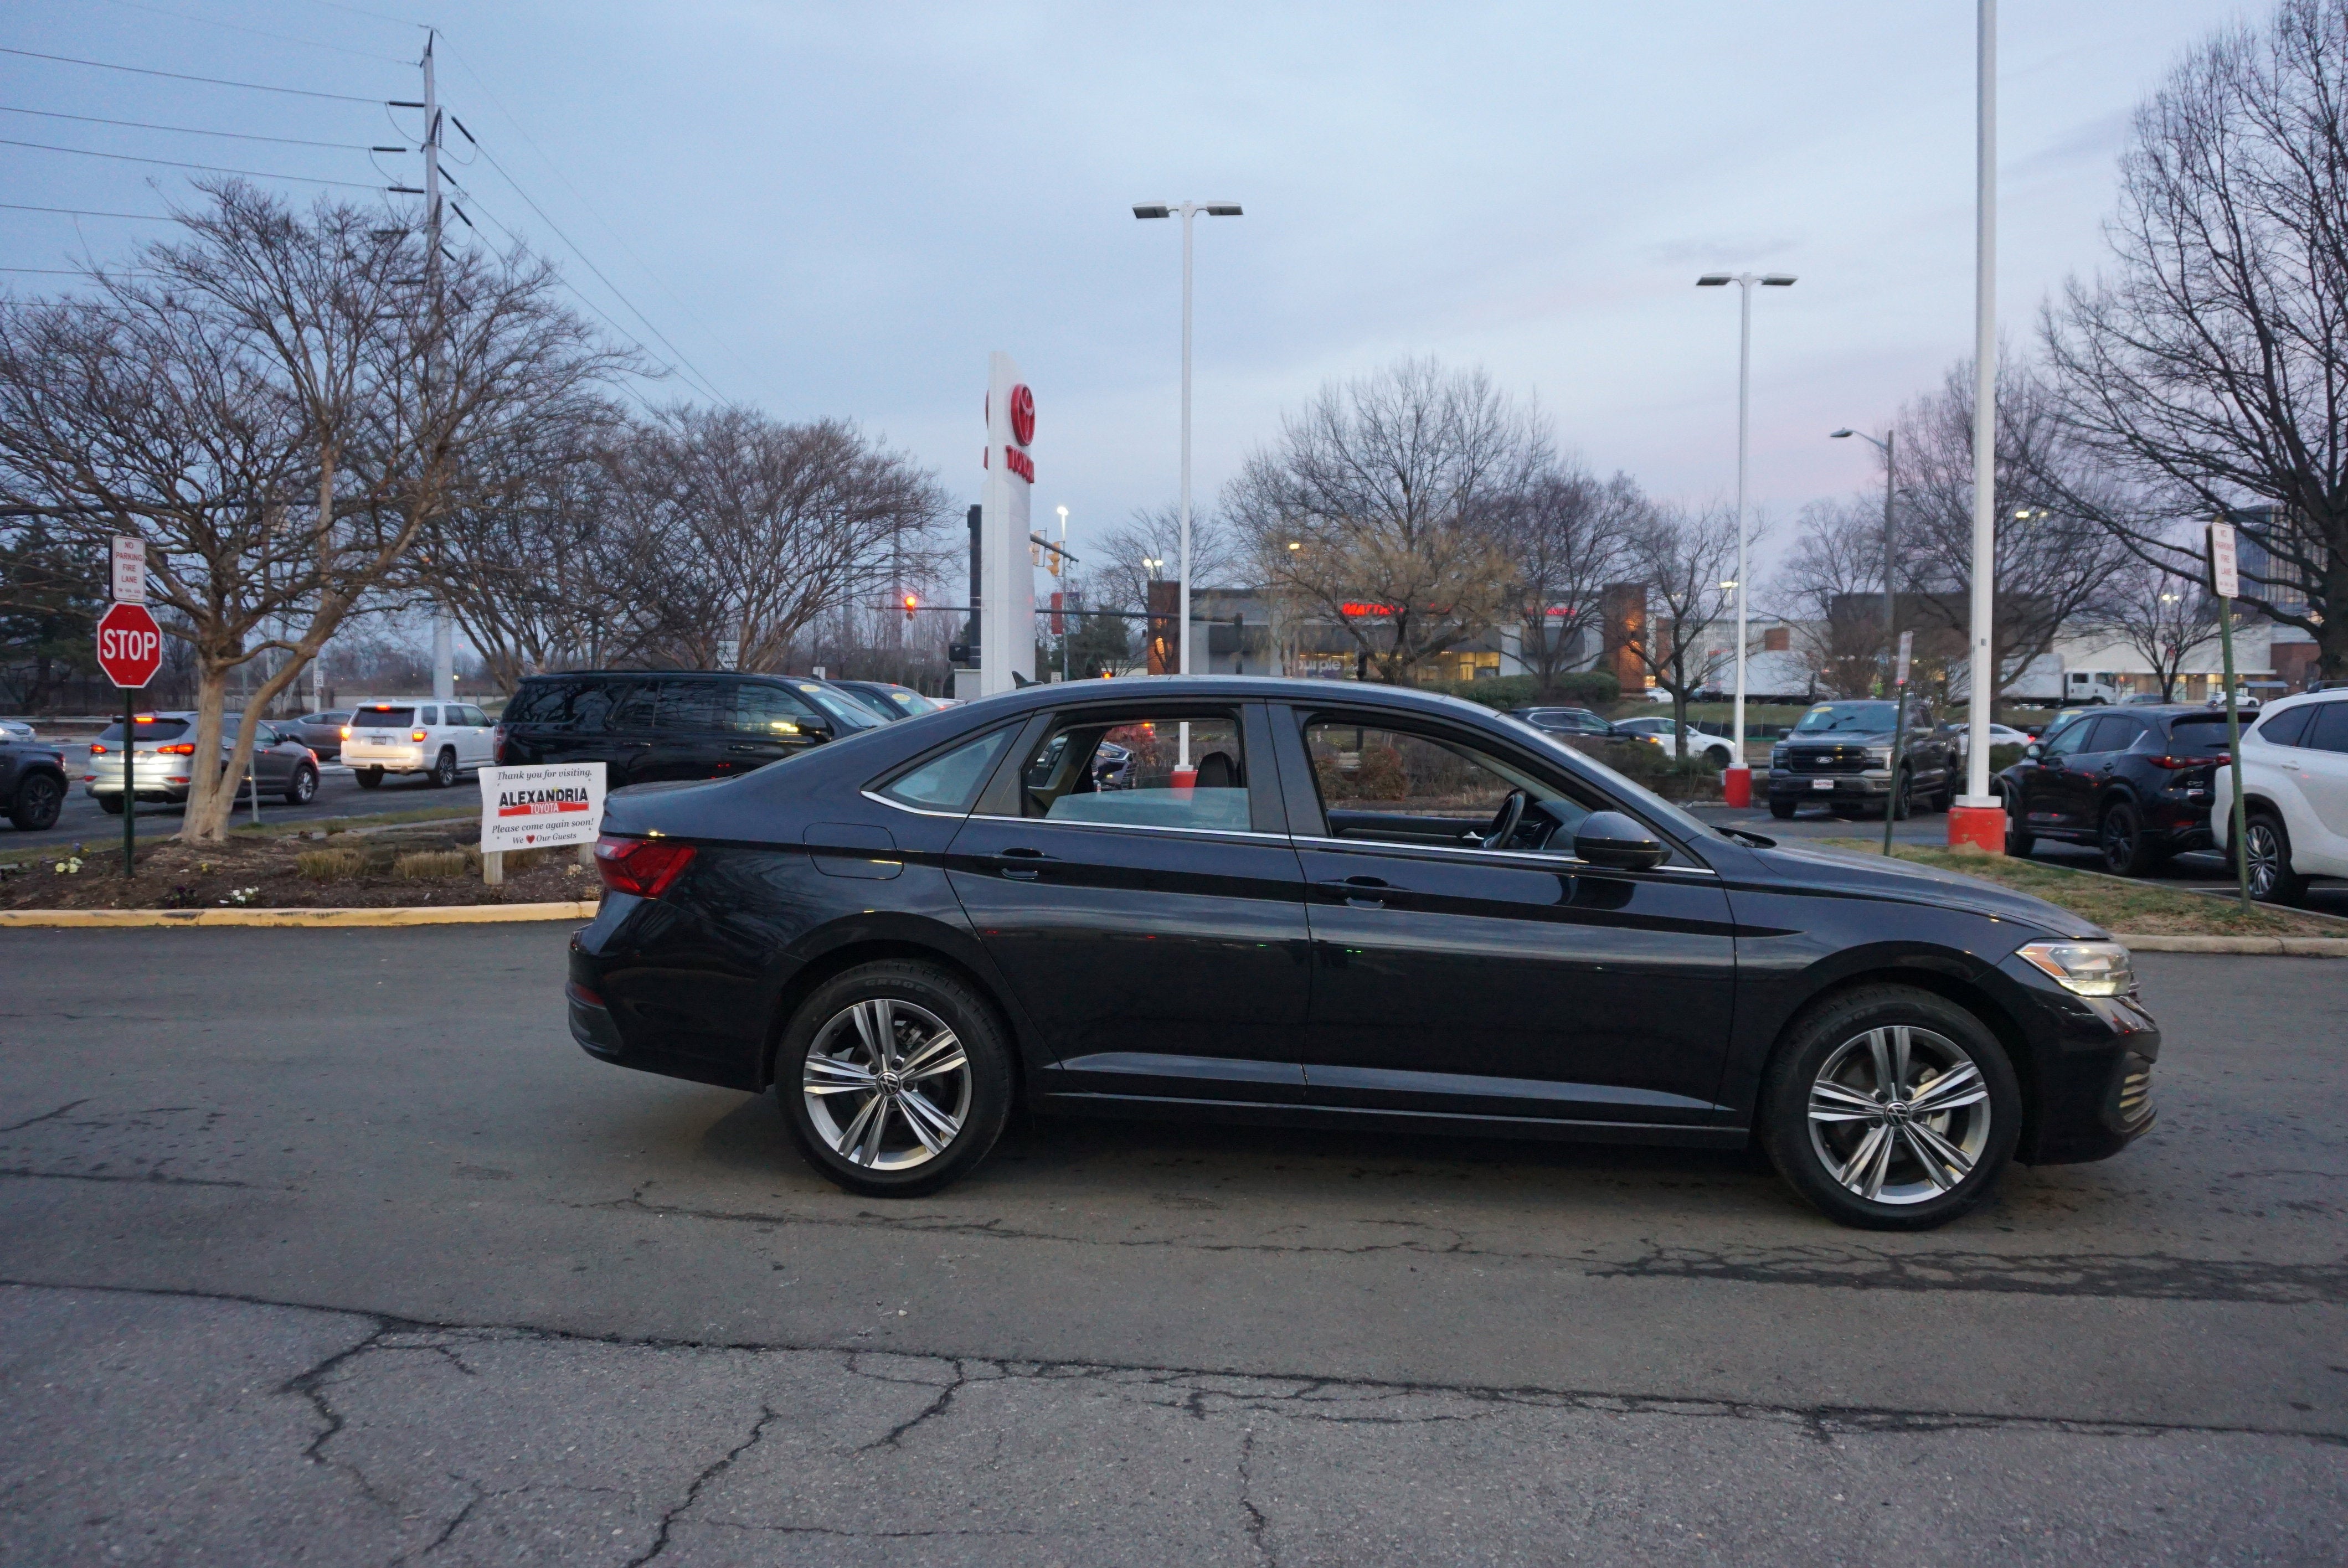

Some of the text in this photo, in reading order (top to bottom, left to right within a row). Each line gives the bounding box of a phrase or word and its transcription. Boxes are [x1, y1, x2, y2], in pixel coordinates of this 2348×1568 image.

[2216, 541, 2234, 551] PARKING
[115, 551, 143, 561] PARKING
[2221, 554, 2230, 563] FIRE
[122, 564, 136, 572] FIRE
[2221, 567, 2232, 576] LANE
[121, 576, 137, 584] LANE
[102, 628, 157, 661] STOP
[497, 768, 592, 781] Thank you for visiting.
[499, 787, 589, 807] ALEXANDRIA
[529, 802, 559, 814] TOYOTA
[492, 818, 594, 834] Please come again soon!
[552, 832, 577, 840] Guests
